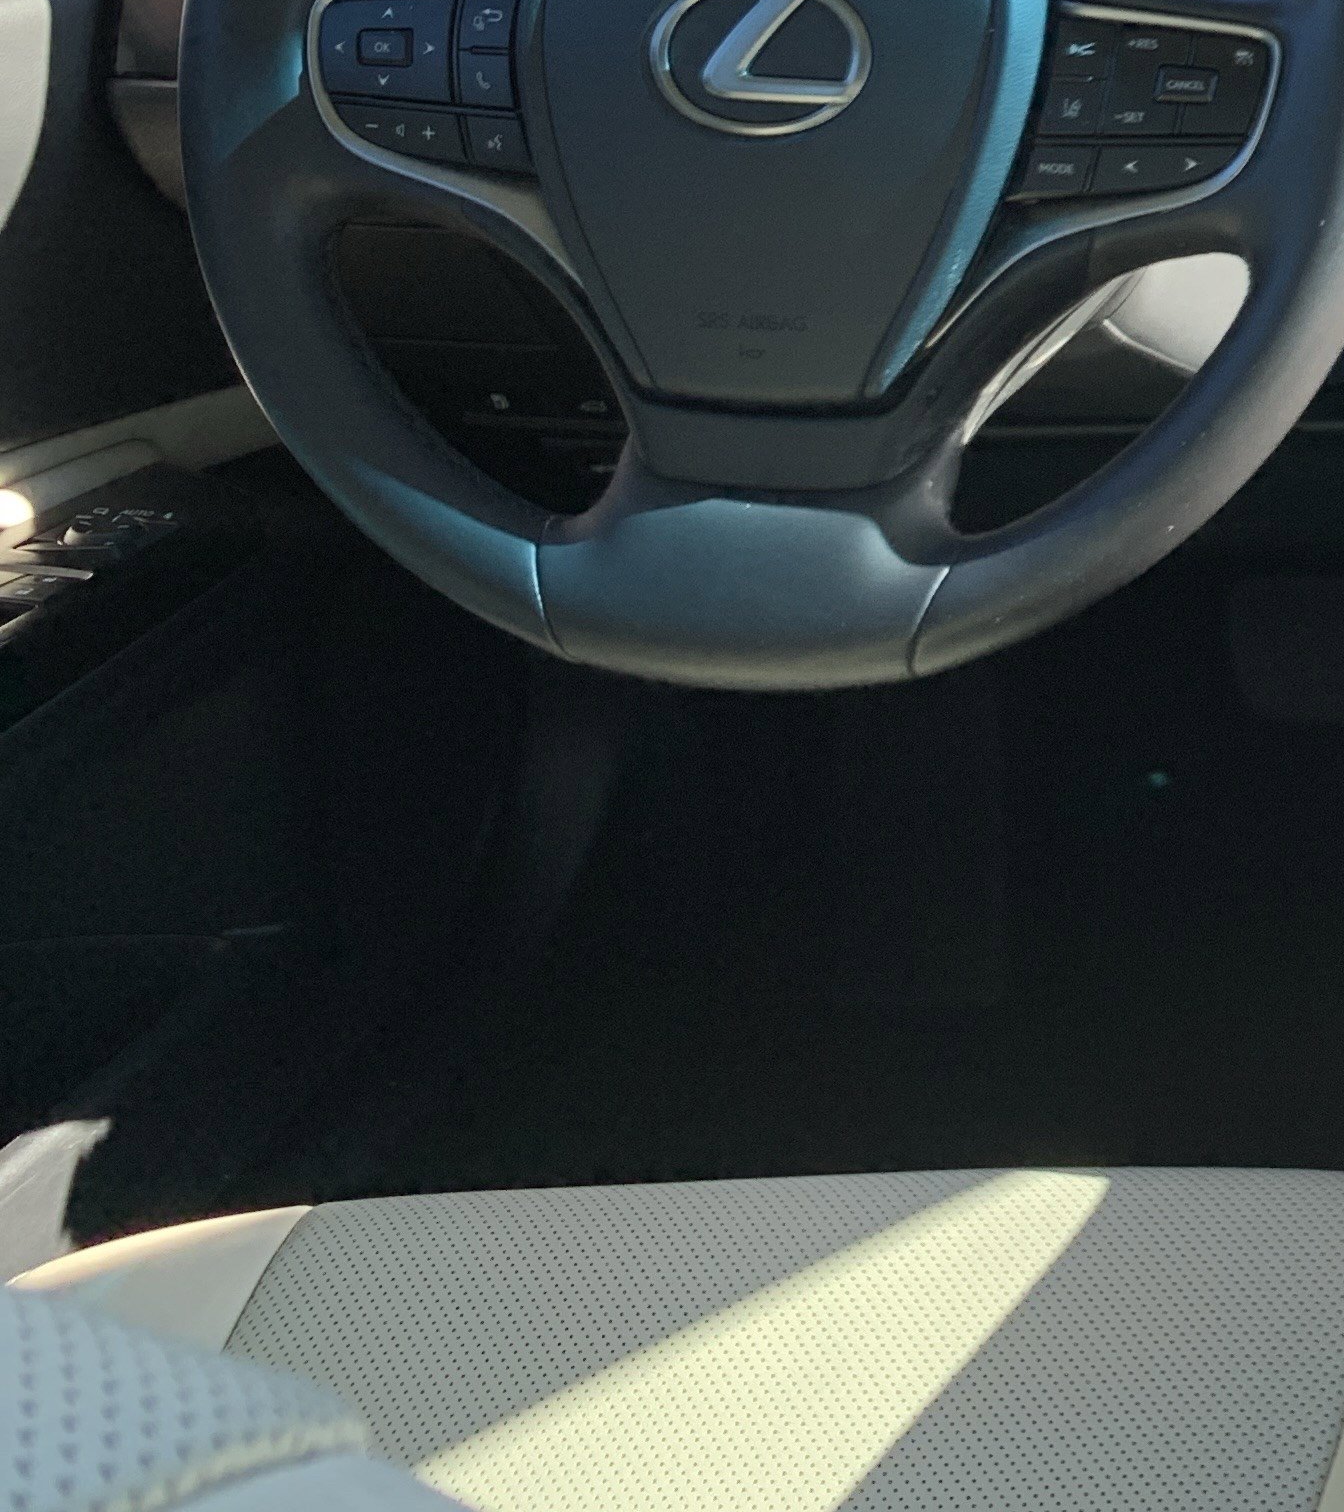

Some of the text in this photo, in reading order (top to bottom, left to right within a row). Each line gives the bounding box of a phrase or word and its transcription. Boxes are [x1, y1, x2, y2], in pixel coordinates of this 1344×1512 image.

[373, 41, 392, 54] OK
[1165, 79, 1206, 92] CANCEL
[1038, 163, 1075, 175] MODE
